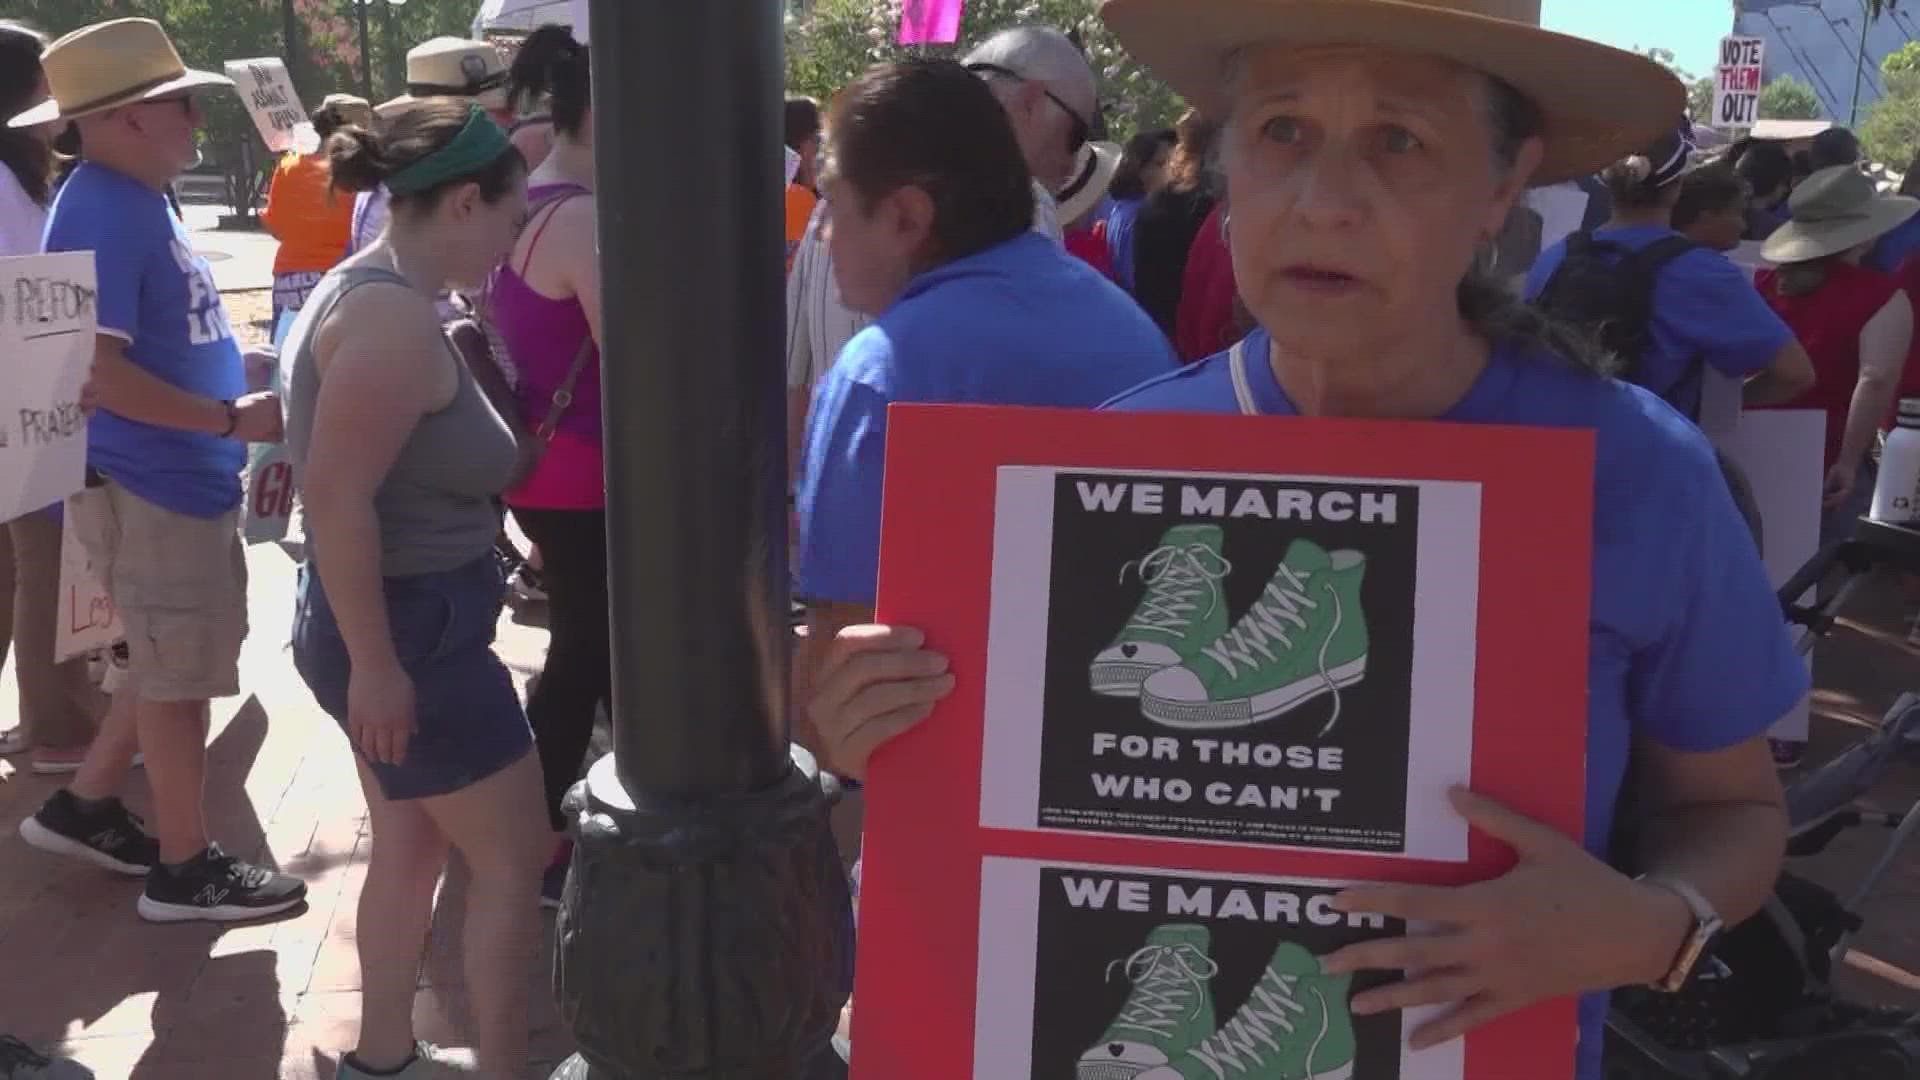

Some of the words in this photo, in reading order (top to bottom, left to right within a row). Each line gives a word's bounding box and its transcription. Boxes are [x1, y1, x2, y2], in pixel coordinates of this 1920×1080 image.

[1722, 39, 1762, 65] VOTE
[1720, 68, 1760, 91] THEM
[1722, 93, 1757, 122] OUT
[1076, 480, 1163, 514] WE
[1180, 484, 1398, 524] MARCH
[1093, 732, 1179, 761] FOR
[1192, 738, 1344, 771] THOSE
[1091, 773, 1192, 802] WHO
[1205, 781, 1341, 812] CAN'T
[1061, 876, 1150, 912] WE
